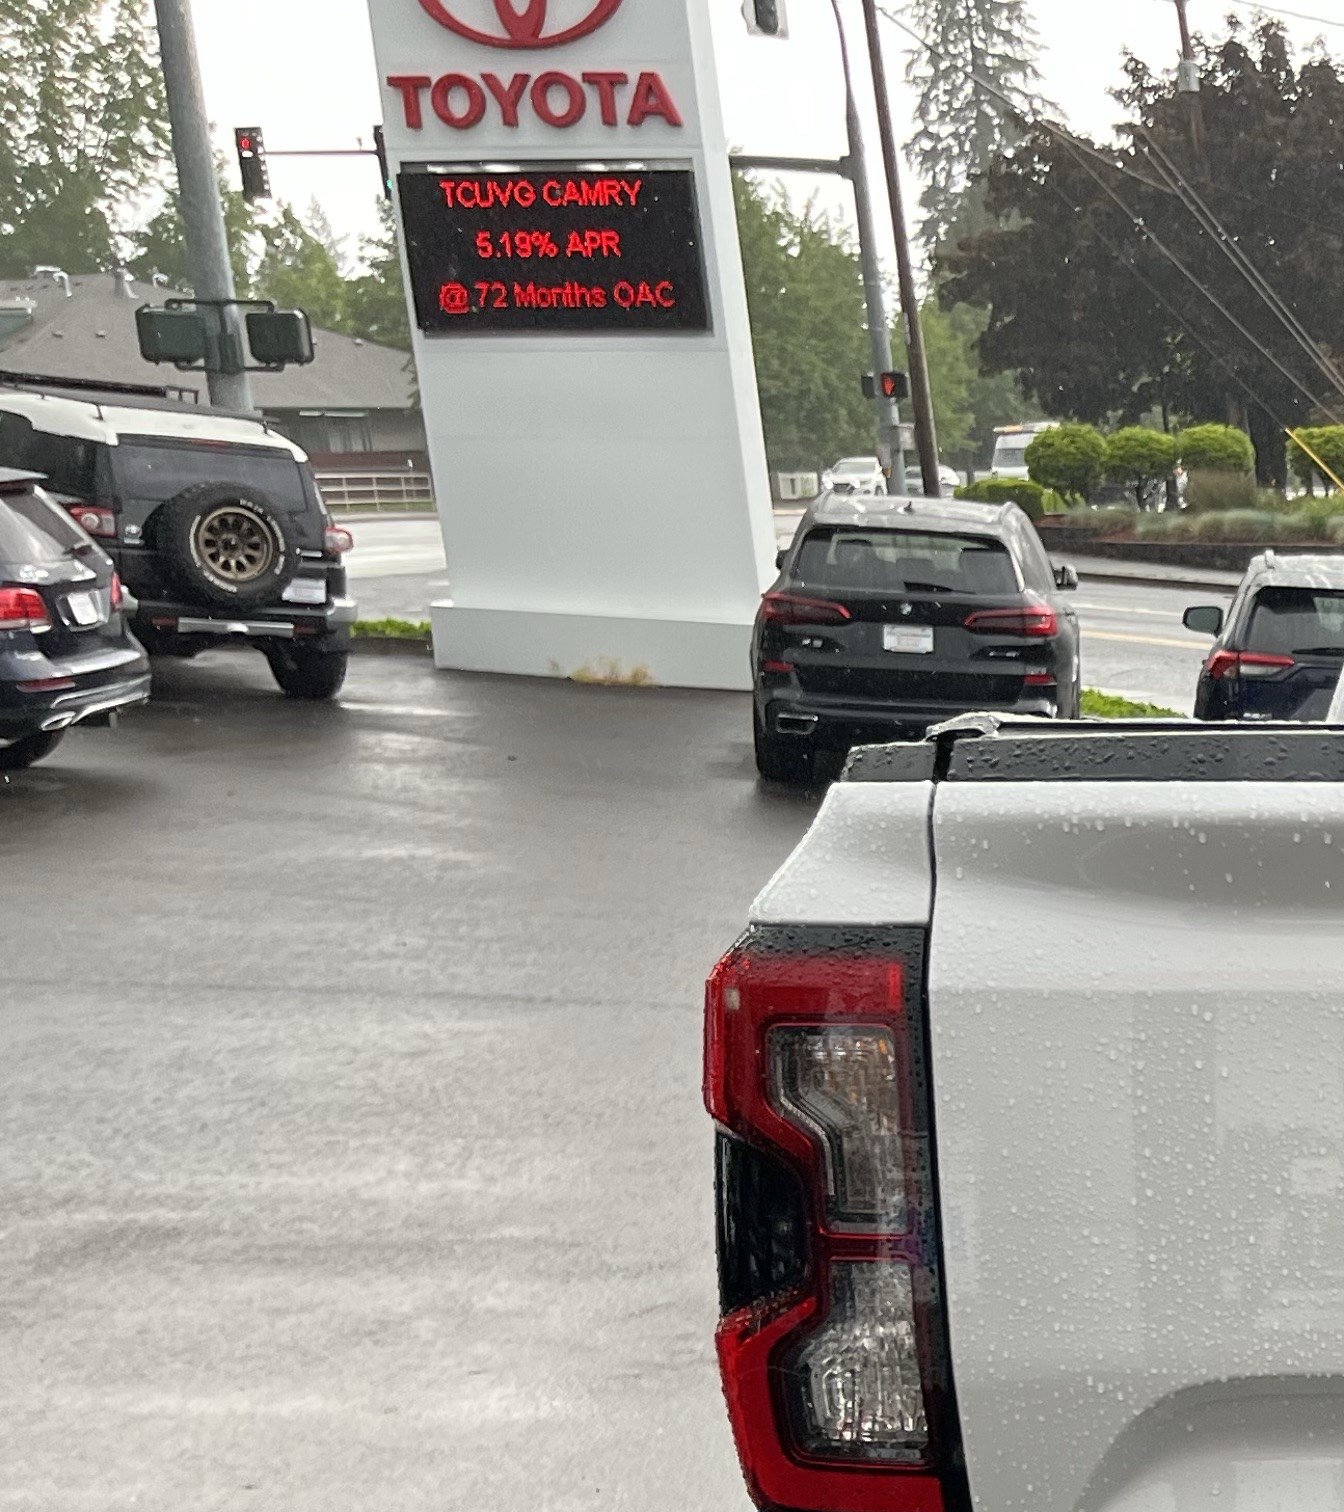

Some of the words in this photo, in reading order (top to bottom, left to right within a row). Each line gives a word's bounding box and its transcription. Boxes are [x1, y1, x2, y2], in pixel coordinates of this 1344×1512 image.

[387, 71, 683, 130] TOYOTA
[439, 180, 537, 208] TCUVG
[542, 179, 642, 207] CAMRY
[475, 230, 559, 258] 5.19%
[566, 230, 622, 257] APR
[438, 281, 469, 314] @
[474, 282, 508, 308] 72
[513, 281, 607, 308] Months
[613, 280, 676, 308] OAC
